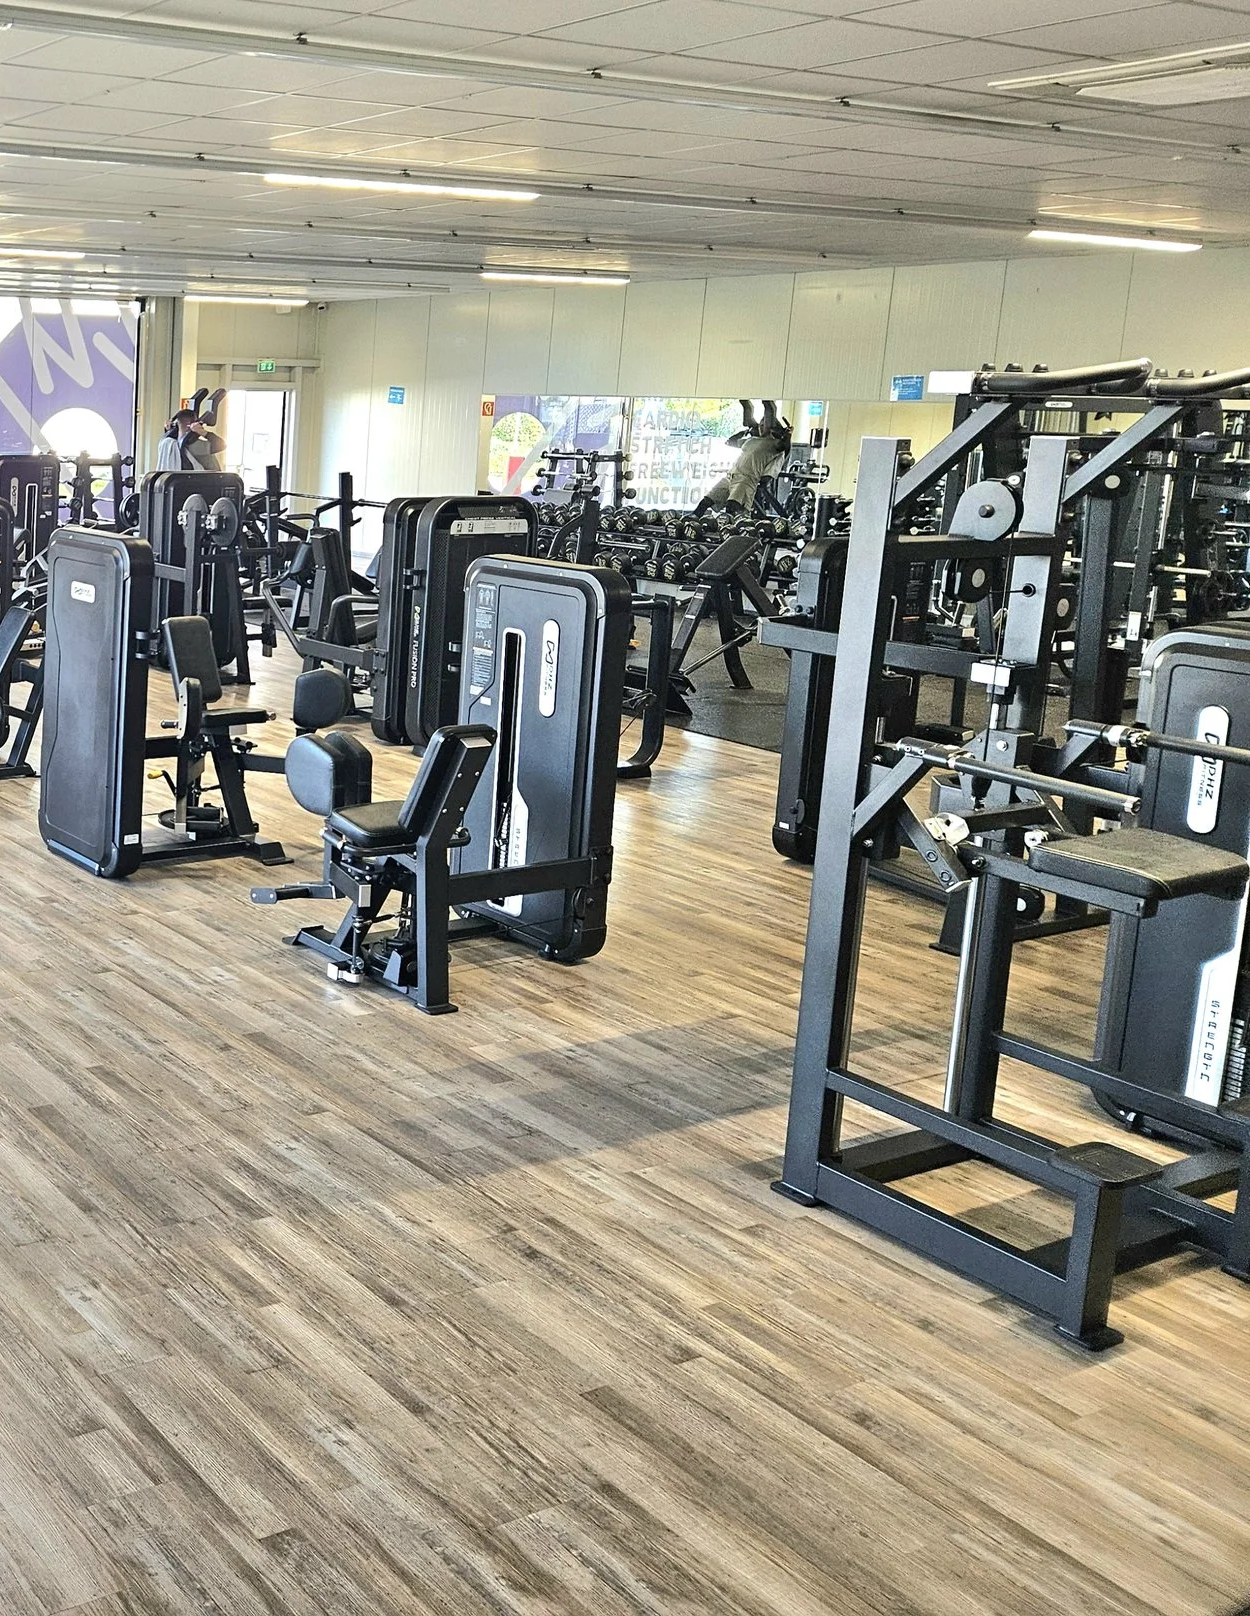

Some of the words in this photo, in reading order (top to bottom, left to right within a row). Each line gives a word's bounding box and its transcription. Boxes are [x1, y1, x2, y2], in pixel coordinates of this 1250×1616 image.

[411, 640, 419, 671] FUSION
[1205, 766, 1217, 800] DHZ
[1200, 1000, 1221, 1083] STRENGTH
